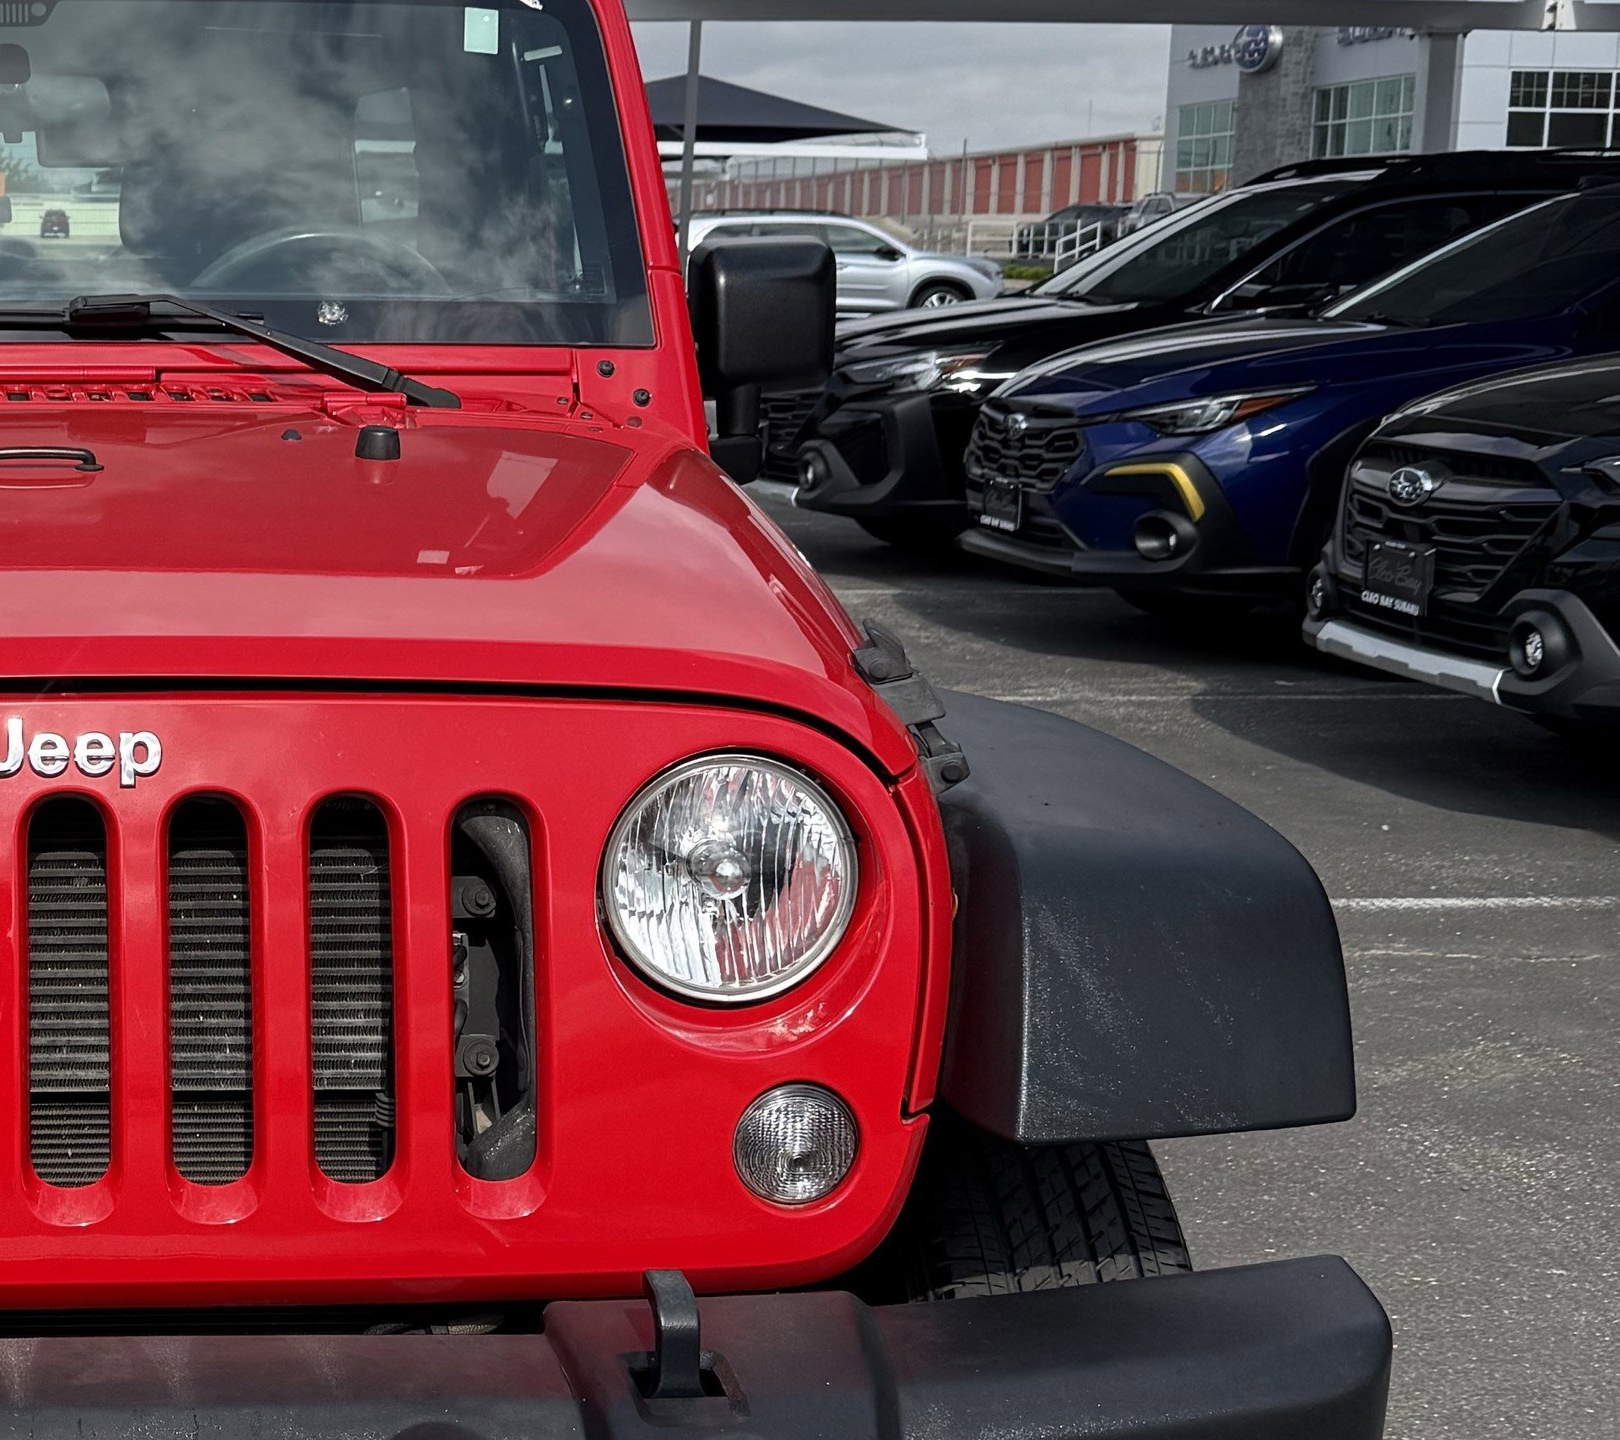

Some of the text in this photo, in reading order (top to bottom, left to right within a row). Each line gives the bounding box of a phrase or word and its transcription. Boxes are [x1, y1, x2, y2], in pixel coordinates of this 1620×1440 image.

[1361, 590, 1420, 616] CLEO BAY SUBARU
